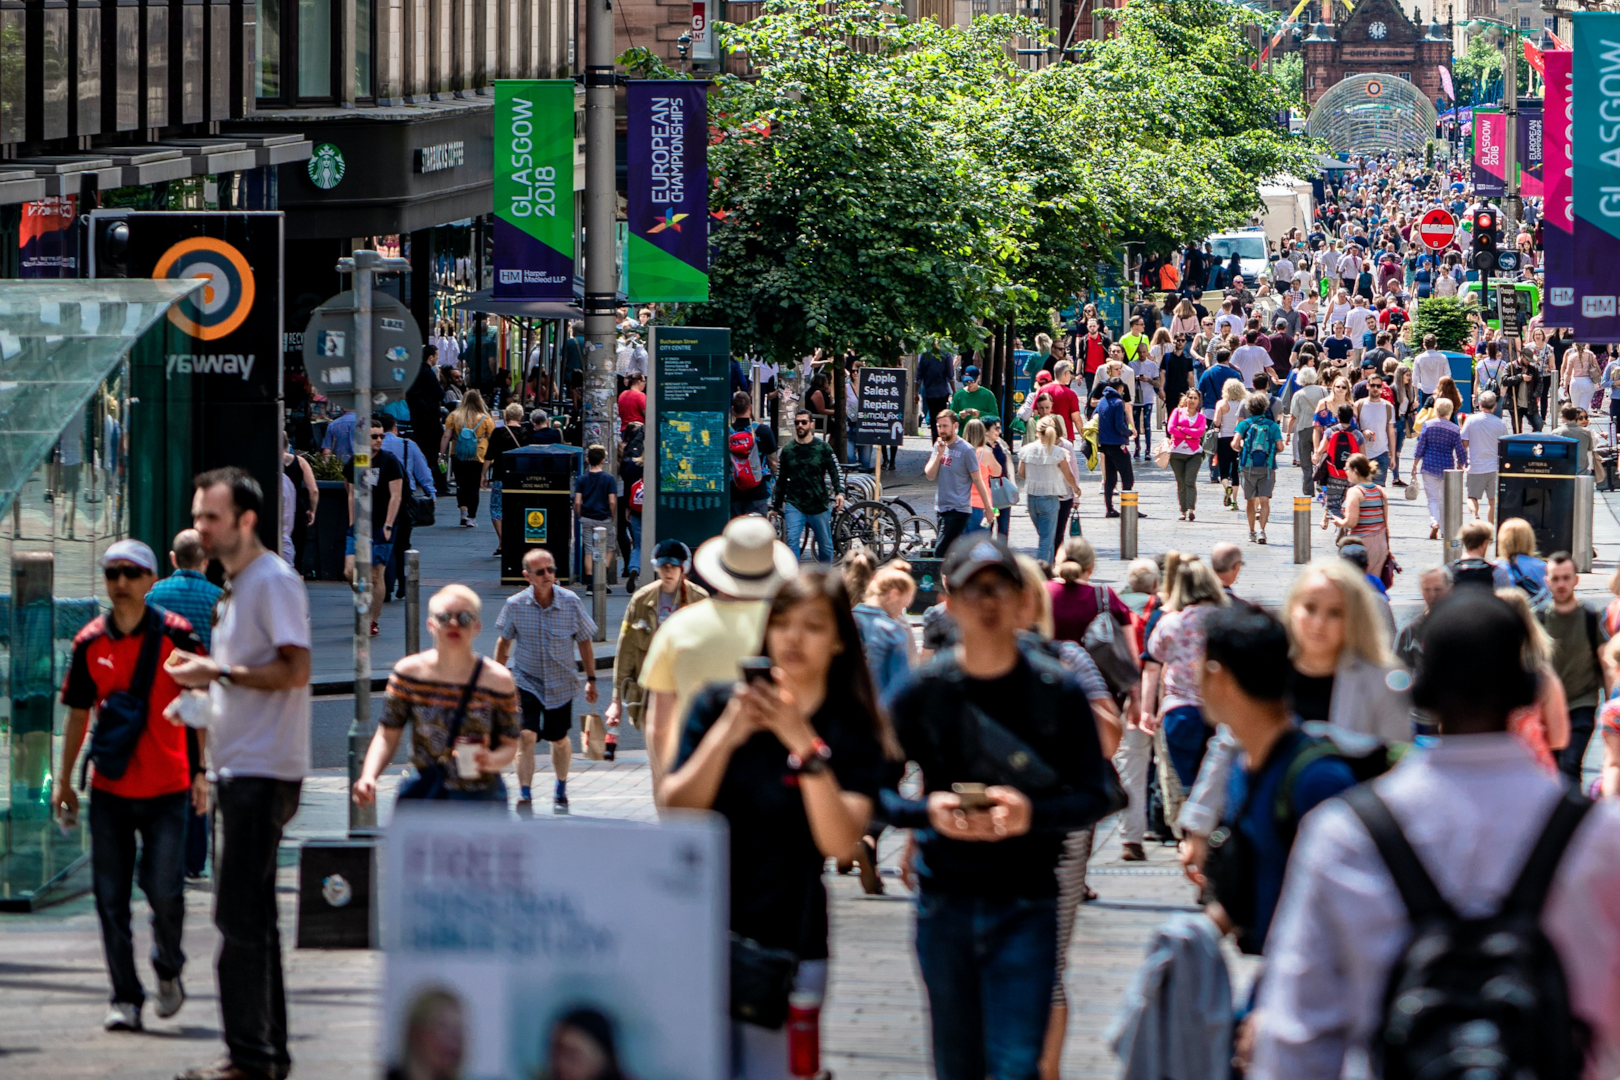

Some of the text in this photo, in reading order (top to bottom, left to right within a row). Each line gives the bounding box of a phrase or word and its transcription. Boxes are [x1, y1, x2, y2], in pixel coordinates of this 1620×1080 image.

[1482, 120, 1491, 165] GLASGOW
[1529, 120, 1537, 160] EUROPEAN
[511, 98, 534, 218] GLASGOW
[651, 98, 670, 203] EUROPEAN
[670, 98, 684, 203] CHAMPIONSHIPS
[1491, 146, 1499, 165] 2018
[535, 166, 556, 218] 2018
[501, 270, 522, 282] HM
[524, 270, 547, 279] Harper
[1586, 299, 1613, 312] HM
[288, 332, 304, 344] RECY
[868, 373, 896, 384] Apple
[864, 386, 899, 396] Sales &
[863, 400, 899, 410] Repairs
